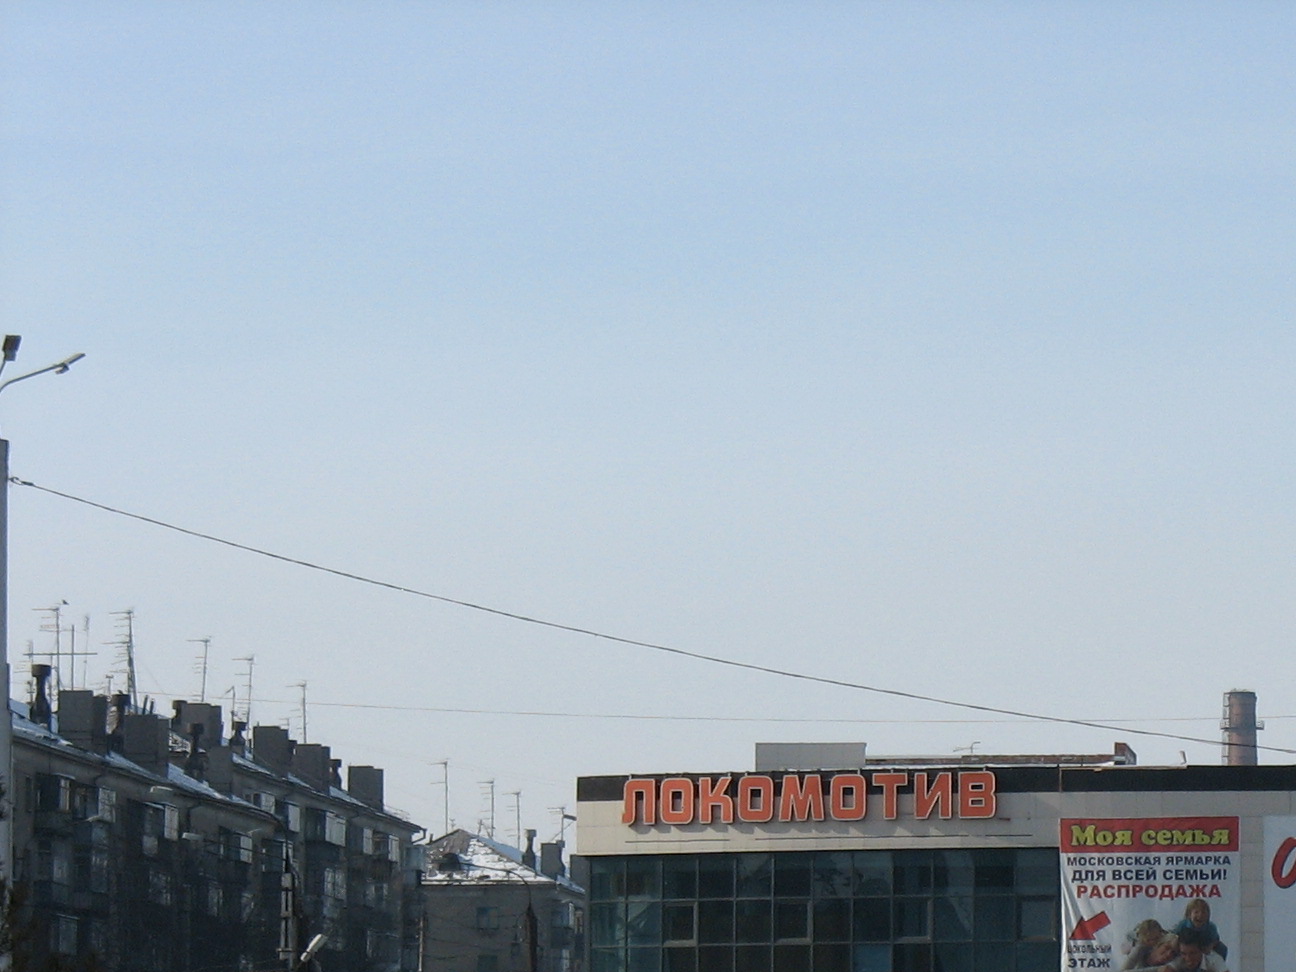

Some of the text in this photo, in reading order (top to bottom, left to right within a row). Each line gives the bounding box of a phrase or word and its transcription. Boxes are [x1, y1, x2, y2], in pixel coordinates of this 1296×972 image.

[622, 771, 996, 826] ЛОКОМОТИВ
[1070, 824, 1230, 846] Моя семья
[1066, 855, 1231, 867] МОСКОВСКАЯ ЯРМАРКА
[1071, 867, 1228, 883] ДЛЯ ВСЕЙ СЕМЬИ!
[1076, 884, 1222, 900] РАСПРОДАЖА
[1067, 957, 1111, 969] ЭТАЖ
